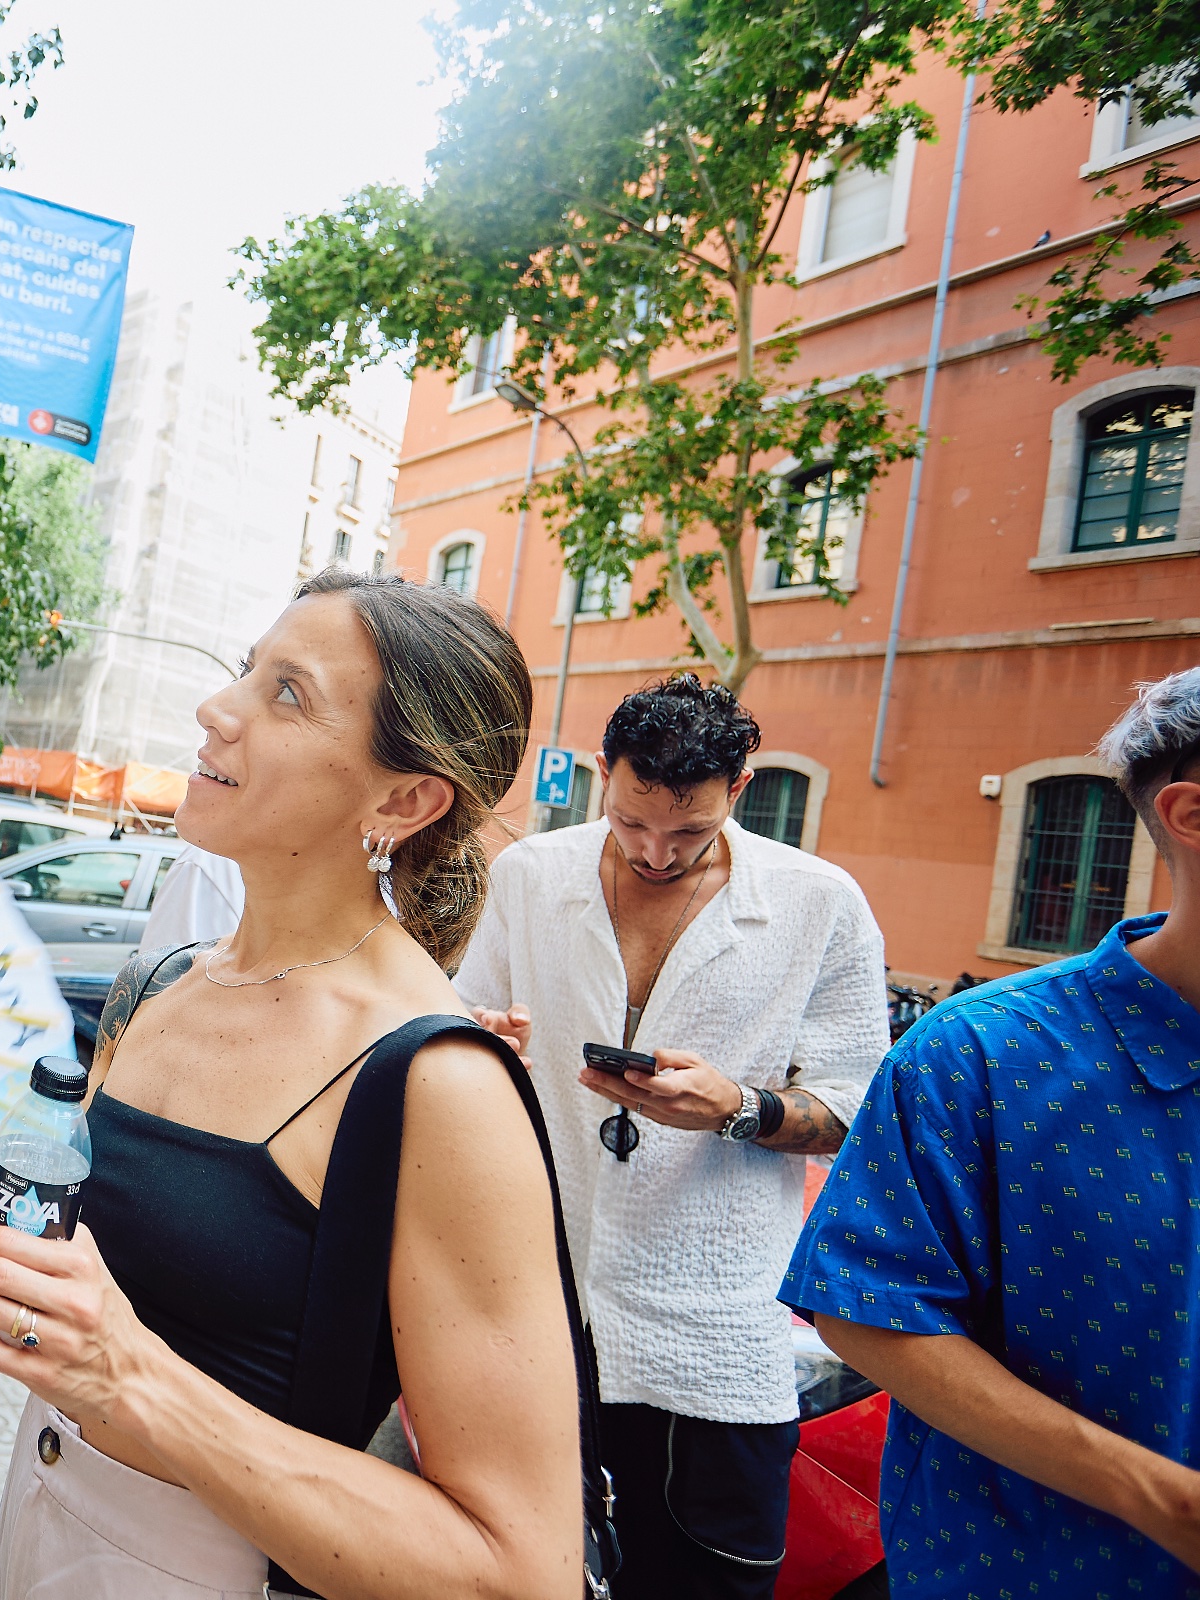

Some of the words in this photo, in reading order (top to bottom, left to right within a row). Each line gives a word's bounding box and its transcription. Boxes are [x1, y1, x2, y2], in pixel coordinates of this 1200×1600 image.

[22, 224, 122, 263] respectes
[31, 270, 100, 299] cuides
[73, 258, 107, 280] del
[18, 284, 73, 315] barri.
[542, 750, 568, 782] P
